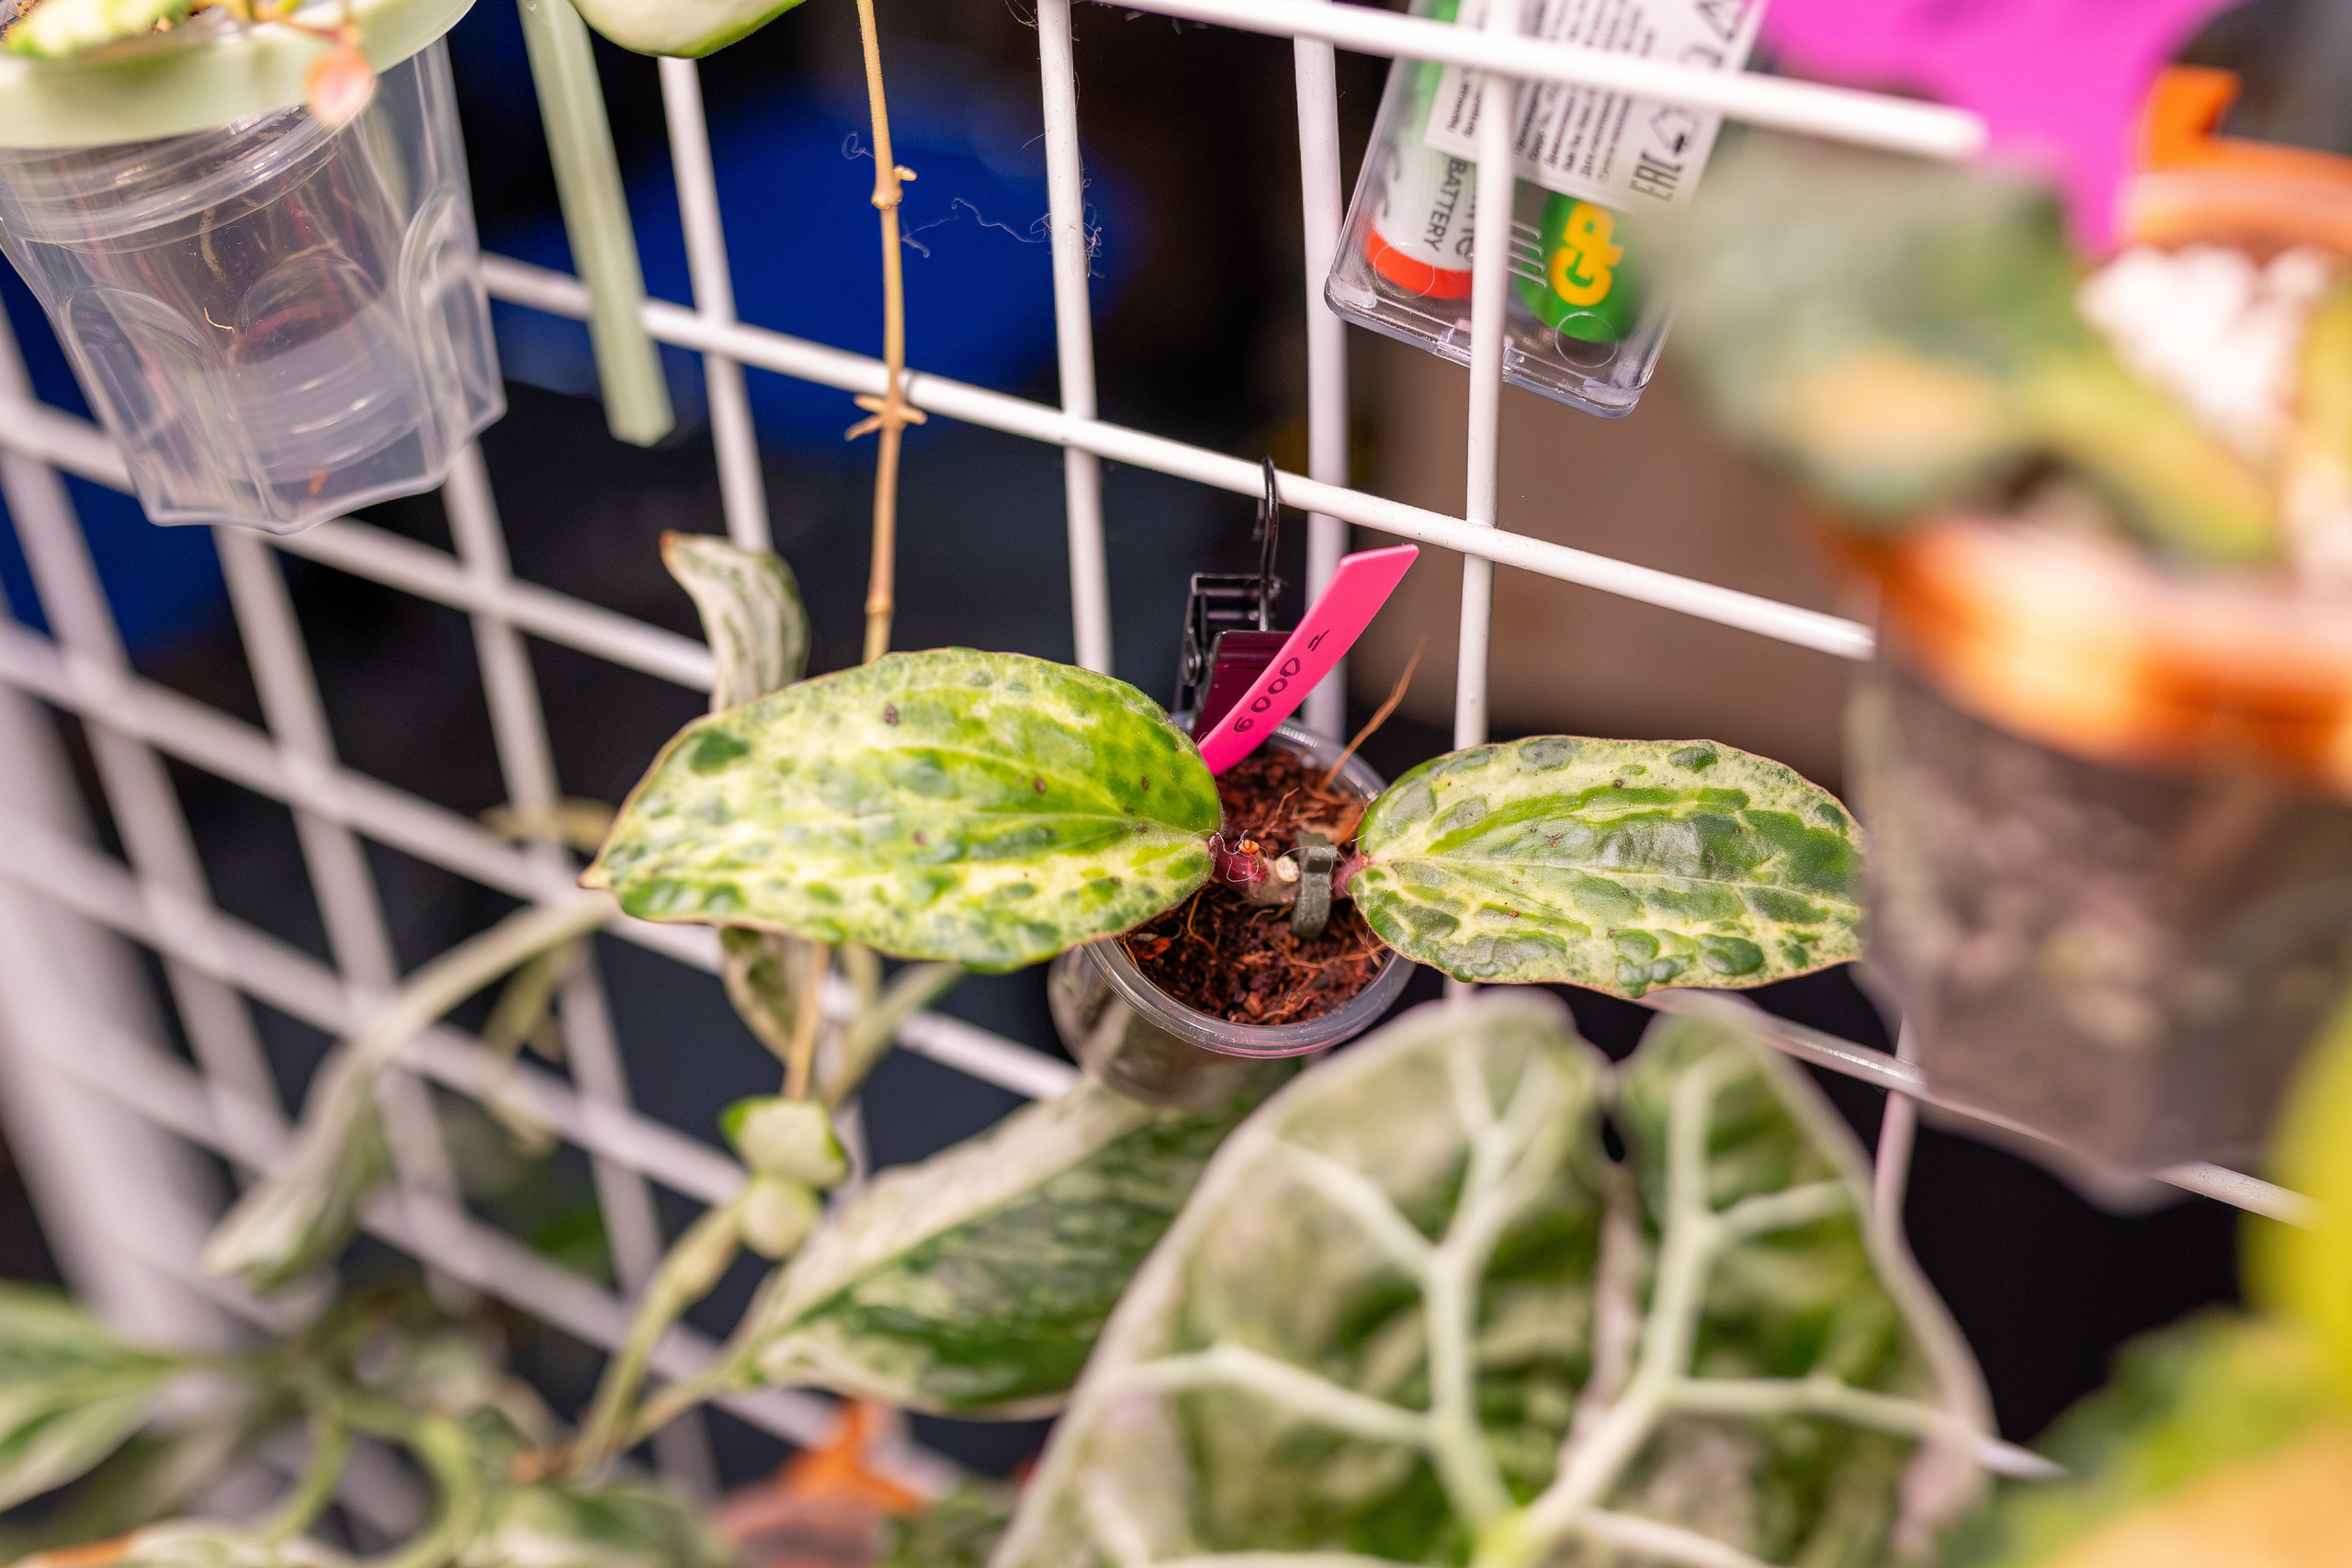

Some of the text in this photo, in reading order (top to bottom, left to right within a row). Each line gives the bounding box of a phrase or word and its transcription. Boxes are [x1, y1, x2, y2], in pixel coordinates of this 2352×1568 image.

[1423, 159, 1469, 252] BATTERY
[1551, 201, 1624, 307] GP
[1233, 657, 1301, 733] 6000
